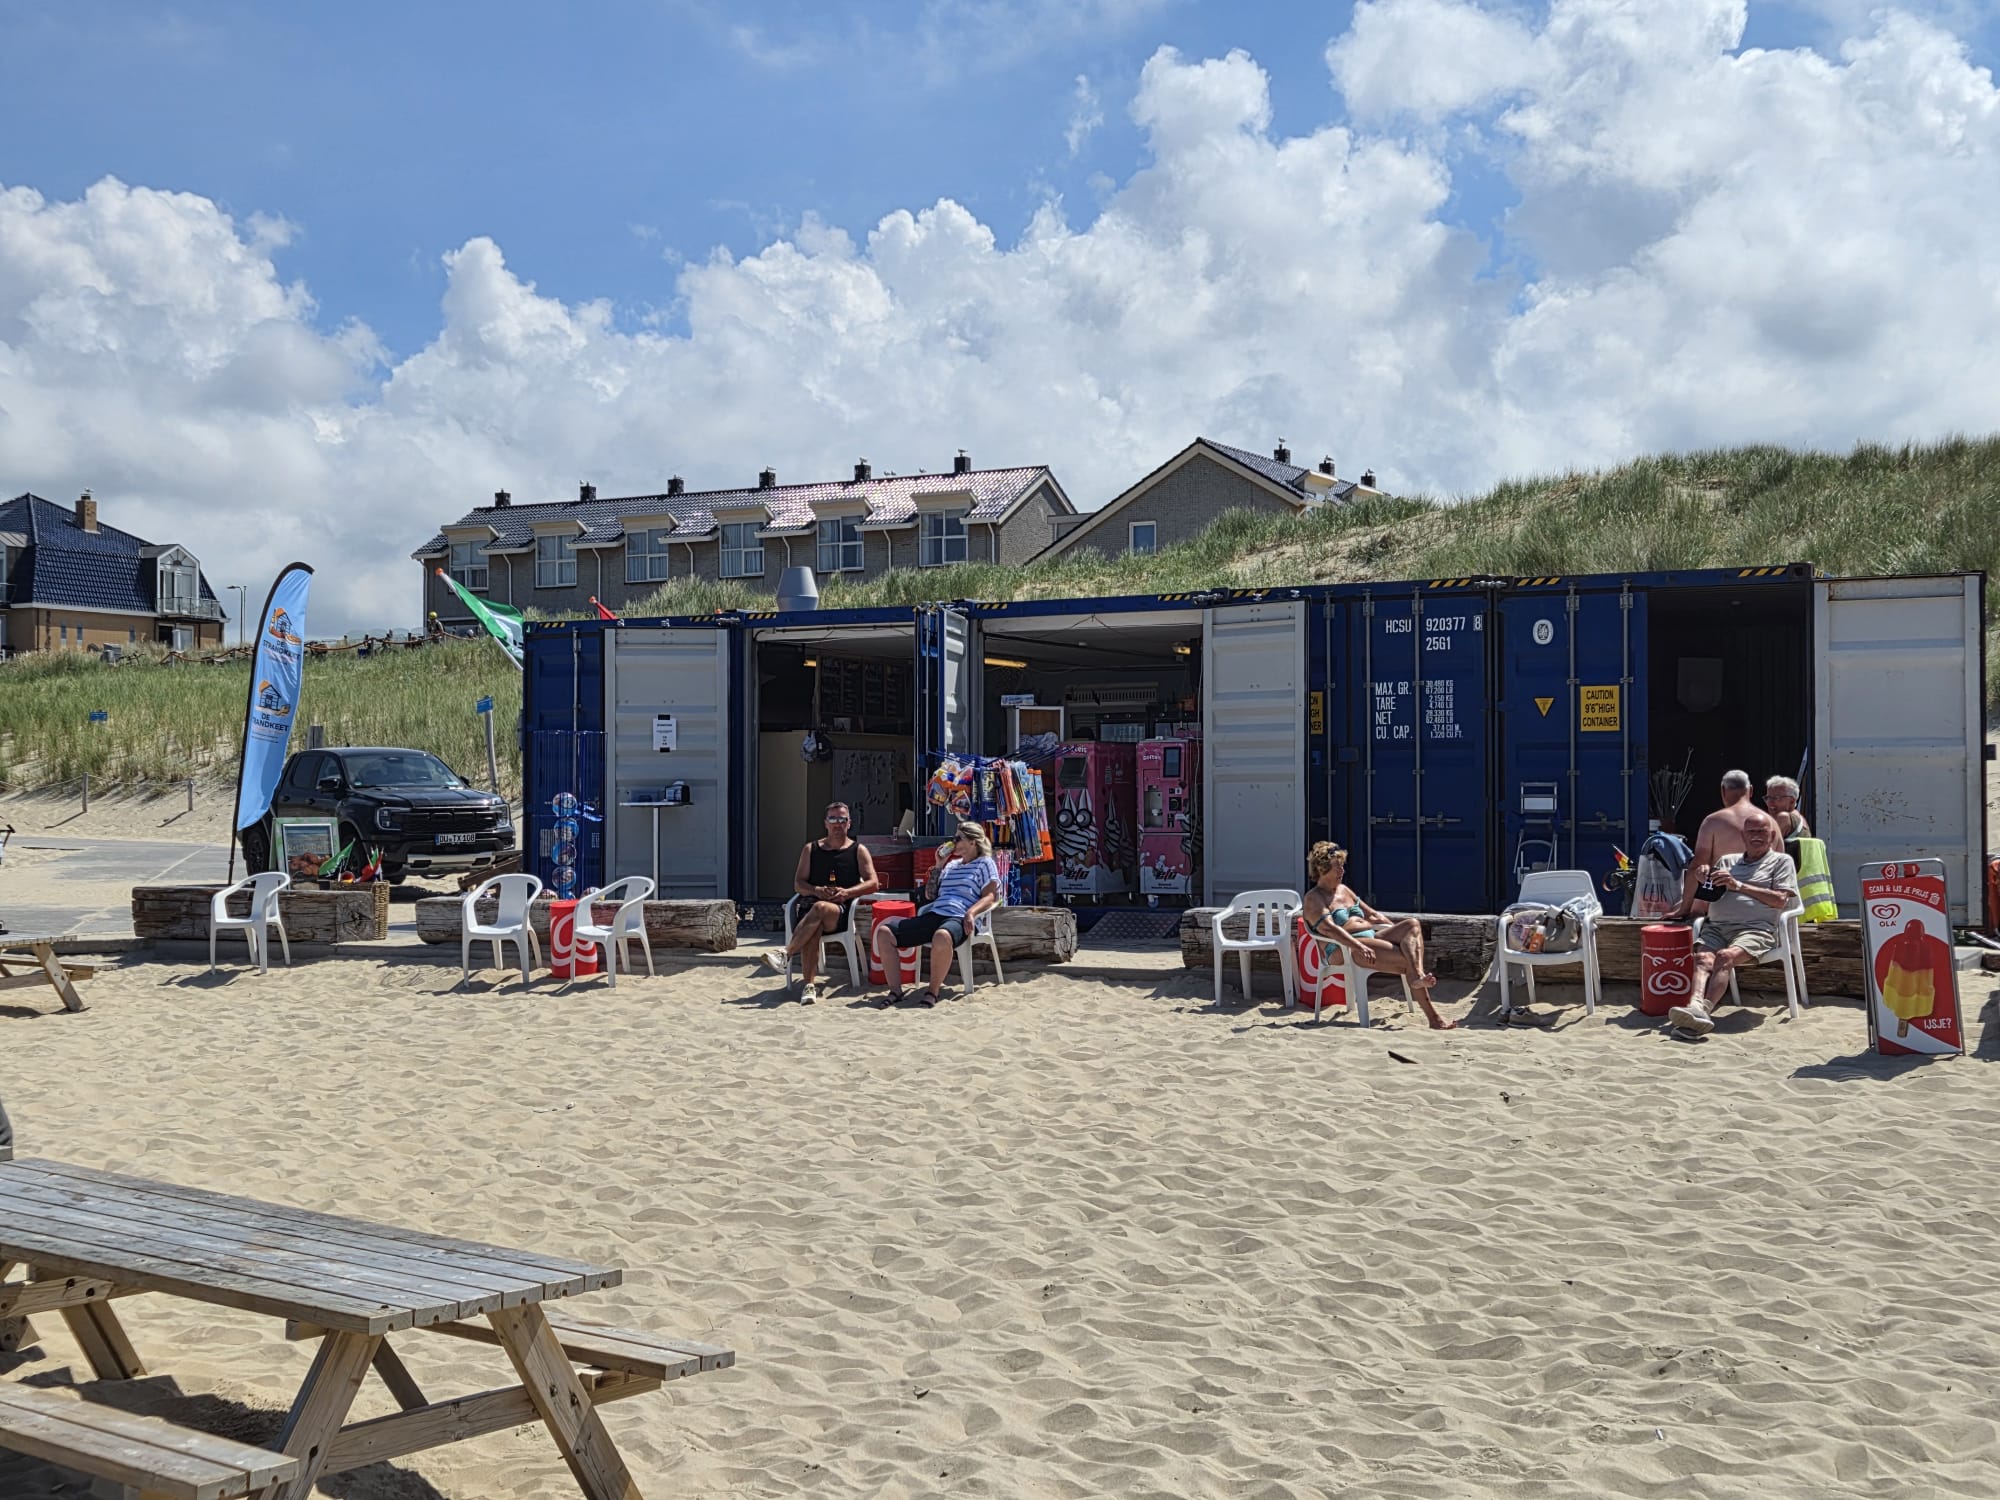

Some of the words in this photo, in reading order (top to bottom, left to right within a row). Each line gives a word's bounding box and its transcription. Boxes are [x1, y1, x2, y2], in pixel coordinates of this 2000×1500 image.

[1385, 619, 1411, 633] HCSU
[1426, 617, 1465, 631] 920377
[1474, 616, 1481, 630] 8
[1426, 636, 1450, 650] 25G1
[1375, 681, 1396, 695] MAX.
[1398, 681, 1412, 695] GR.
[1586, 690, 1614, 700] CAUTION
[1376, 696, 1396, 710] TARE
[262, 713, 271, 721] DE
[1375, 711, 1392, 725] NET
[1583, 717, 1617, 727] CONTAINER
[1376, 726, 1389, 739] CU.
[1393, 725, 1413, 739] CAP.
[1869, 885, 1883, 893] SCAN
[1904, 886, 1911, 894] JE
[1912, 887, 1929, 898] PRIJS
[1923, 1018, 1952, 1029] IJSJE?
